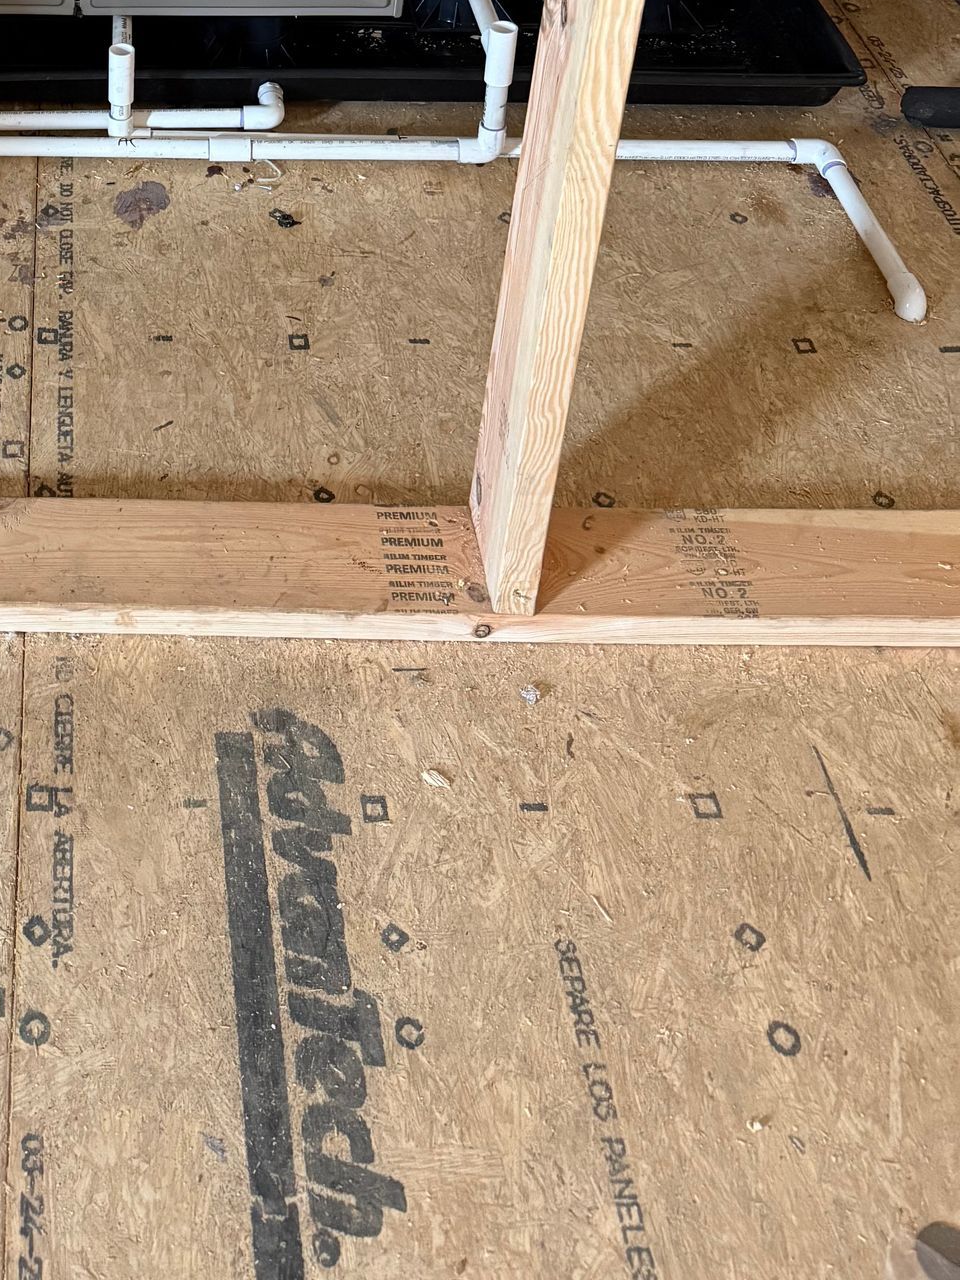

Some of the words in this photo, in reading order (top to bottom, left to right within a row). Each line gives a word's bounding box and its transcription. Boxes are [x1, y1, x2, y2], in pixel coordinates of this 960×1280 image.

[58, 229, 74, 267] CLOSE
[57, 387, 74, 464] LENGUETA
[376, 511, 438, 520] PREMIUM
[381, 537, 444, 548] PREMIUM
[412, 553, 447, 561] TIMBER
[385, 563, 450, 575] PREMIUM
[416, 580, 454, 588] TIMBER
[391, 591, 455, 602] PREMIUM
[553, 937, 601, 1051] SEPARE
[582, 1062, 617, 1123] LOS
